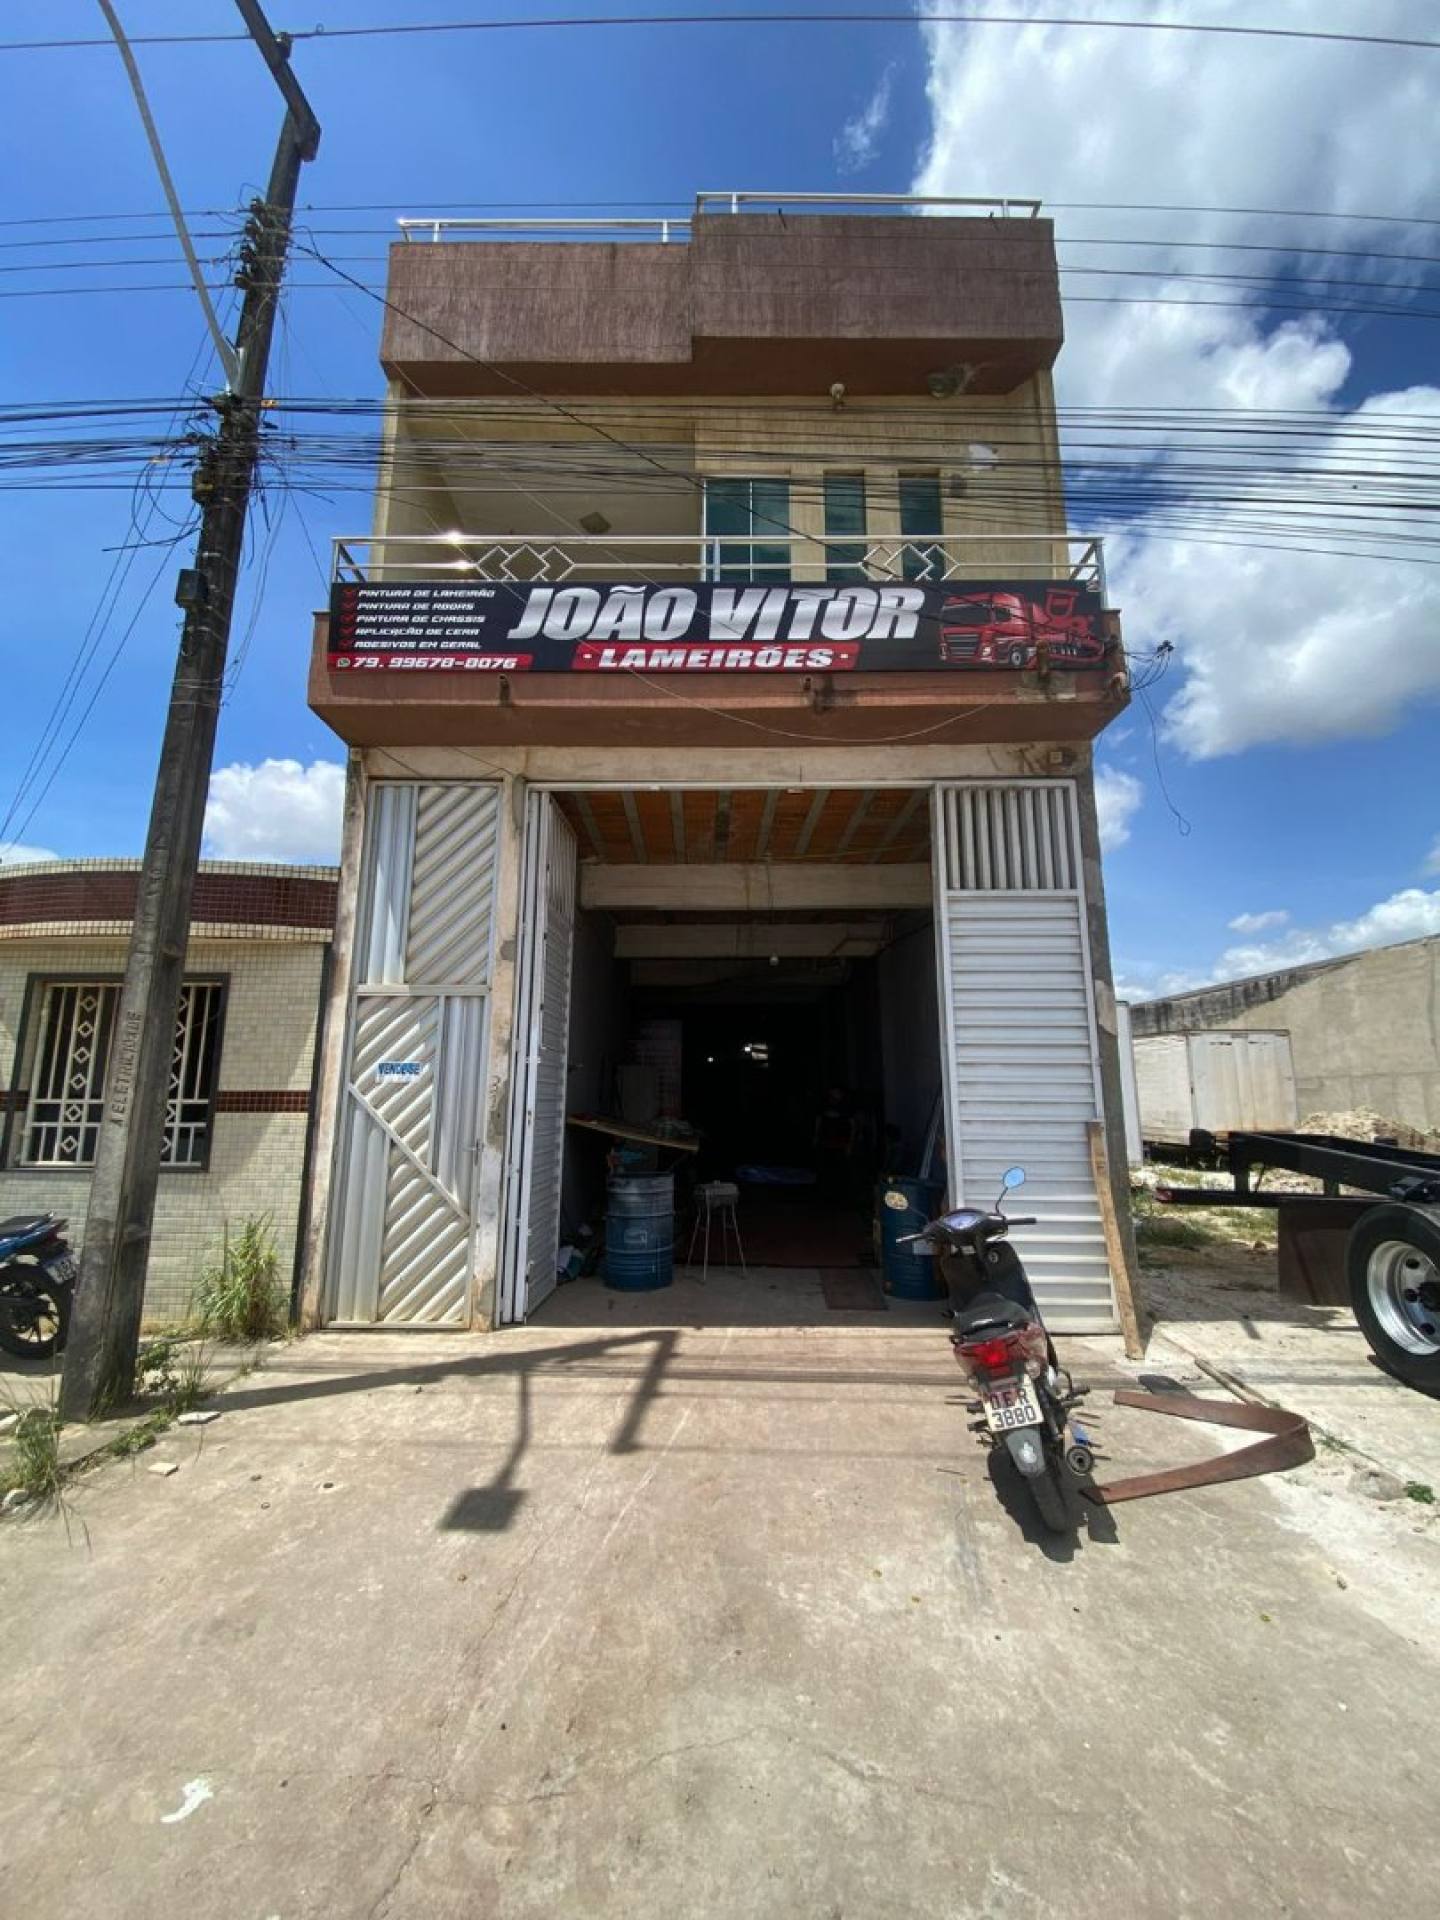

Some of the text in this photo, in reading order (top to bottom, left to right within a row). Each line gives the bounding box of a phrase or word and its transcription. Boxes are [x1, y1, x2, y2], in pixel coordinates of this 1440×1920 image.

[358, 588, 495, 598] PINTURA DE LAMEIRÃO
[357, 602, 475, 611] PINTURA DE RODAS
[507, 585, 926, 641] JOÃO VITOR
[356, 615, 486, 623] PINTURA DE CHASSIS
[355, 626, 480, 637] APLICAÇÃO DE CERA
[354, 641, 481, 649] ADESIVOS EM GERAL
[597, 643, 836, 669] LAMEIRÕES
[991, 1405, 1037, 1428] 3880
